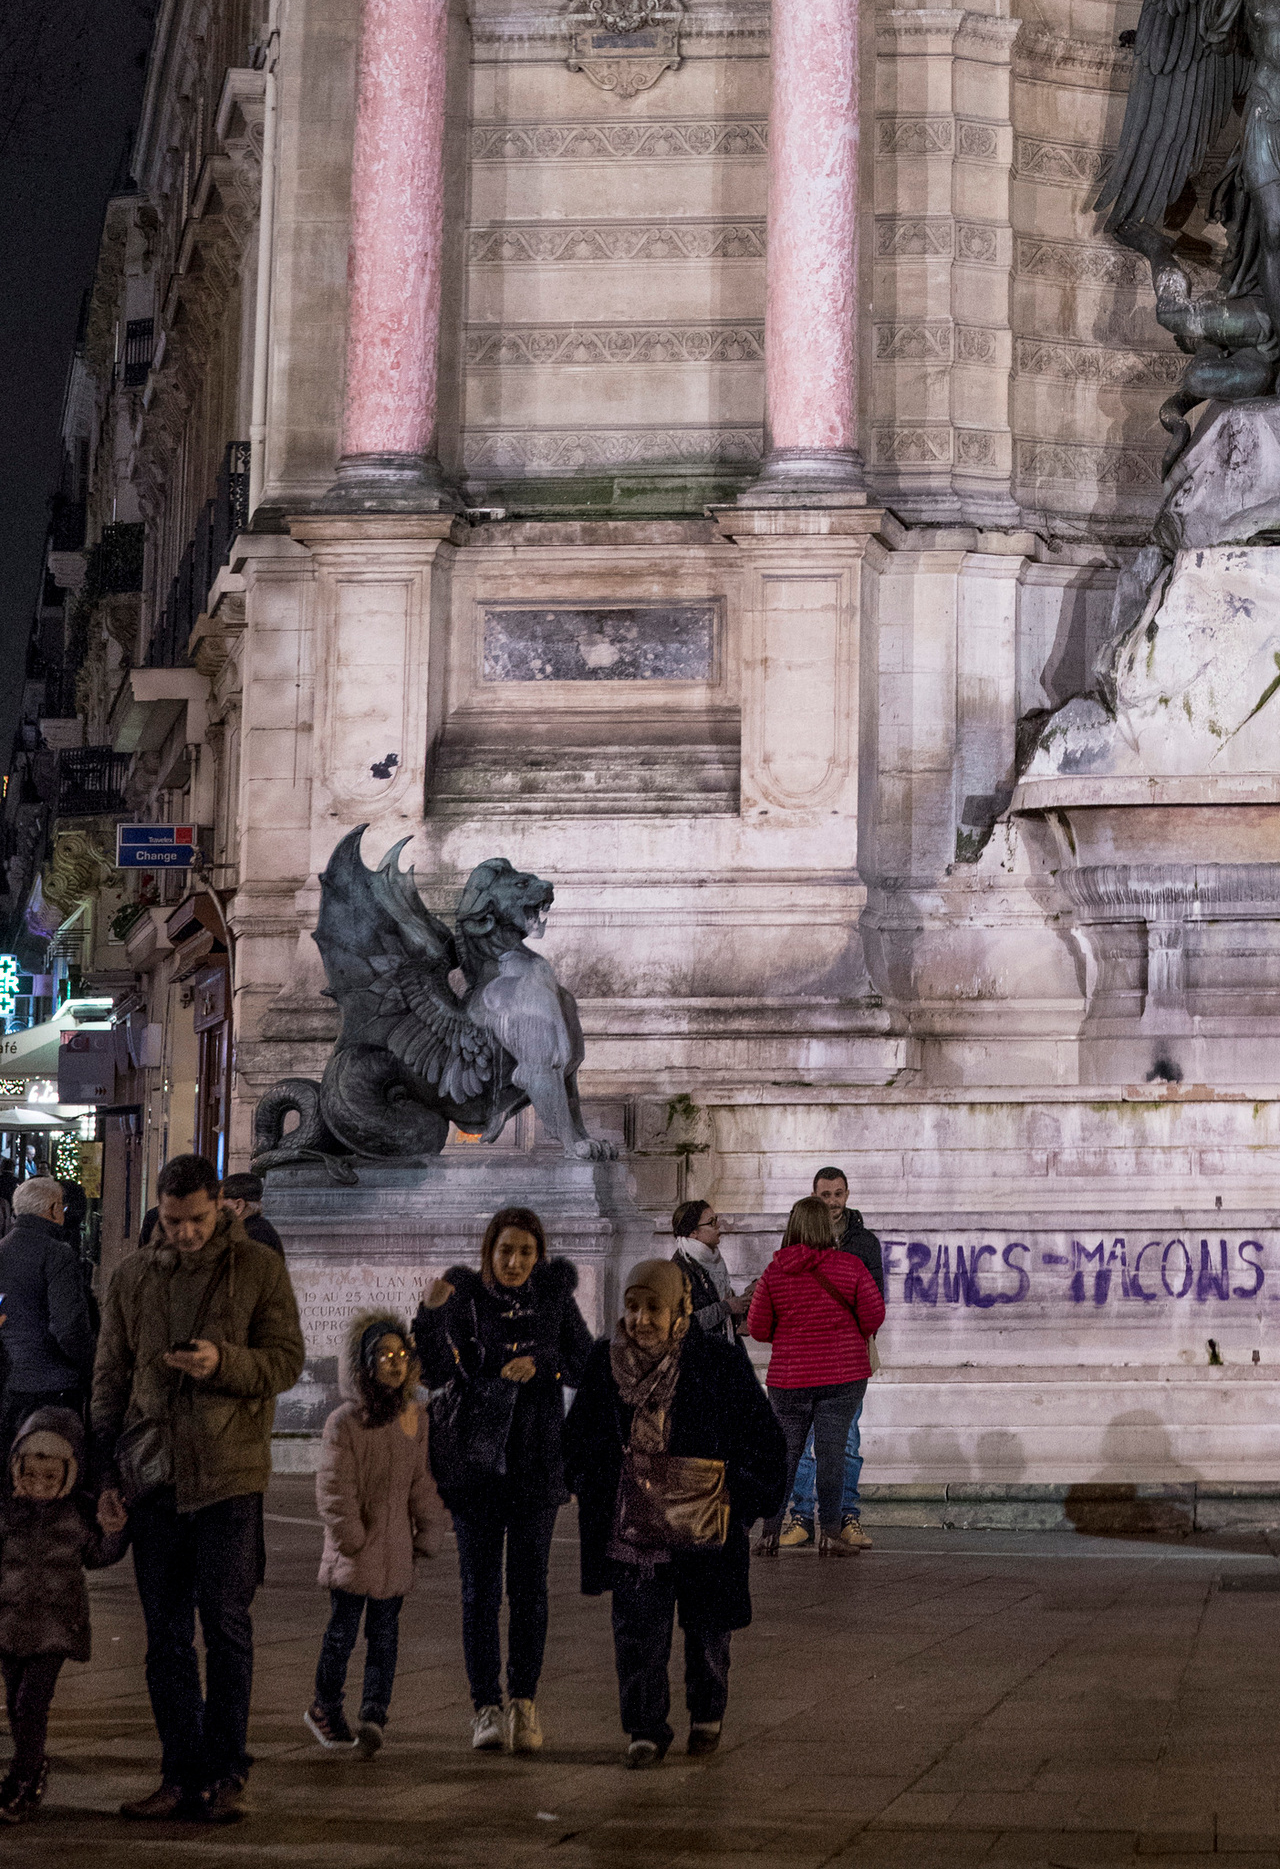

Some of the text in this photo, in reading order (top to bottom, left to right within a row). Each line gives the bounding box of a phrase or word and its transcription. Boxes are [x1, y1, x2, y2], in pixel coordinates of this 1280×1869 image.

[136, 850, 177, 863] Change
[376, 1276, 405, 1288] L'AN
[304, 1292, 317, 1303] 19
[322, 1292, 339, 1303] AU
[345, 1292, 361, 1303] 25
